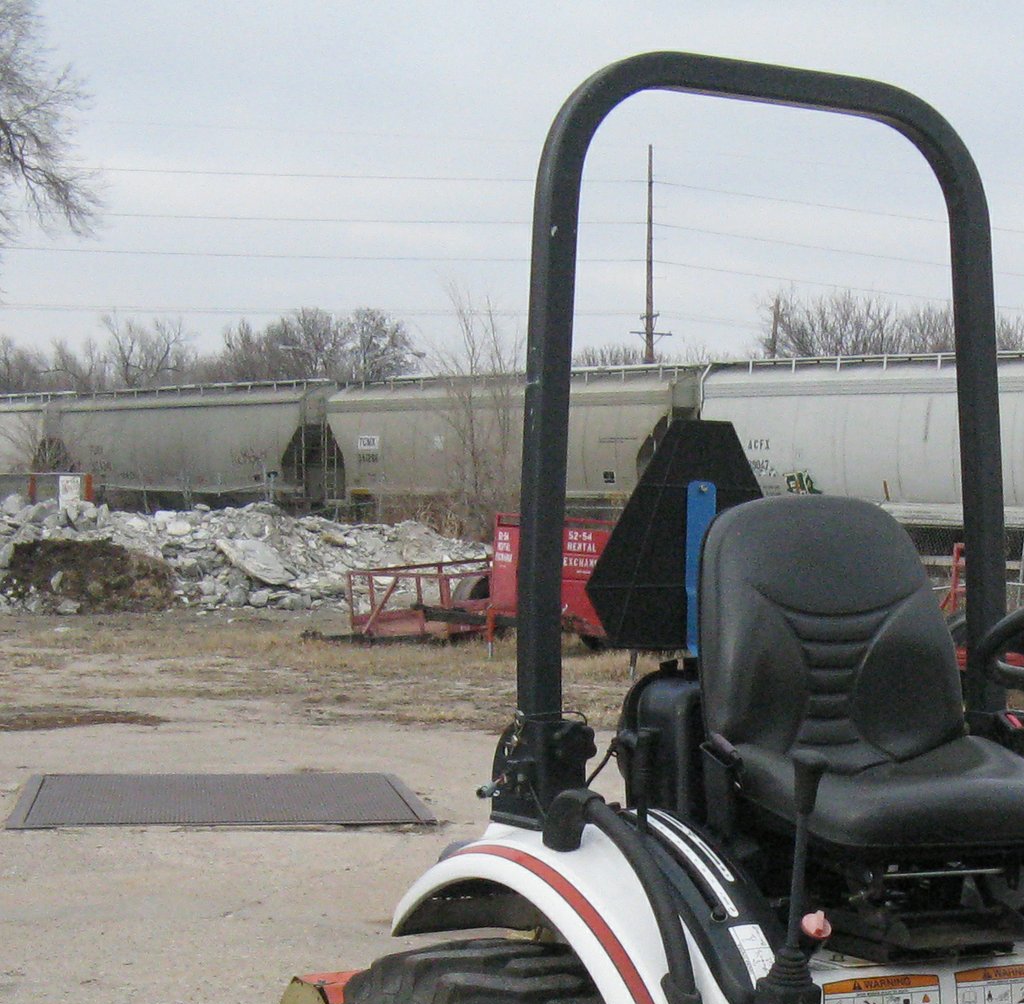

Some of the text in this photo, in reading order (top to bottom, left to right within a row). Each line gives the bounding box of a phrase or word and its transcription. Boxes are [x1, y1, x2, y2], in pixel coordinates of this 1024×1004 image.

[748, 439, 770, 450] ACFX
[567, 542, 596, 553] RENTAL
[563, 556, 598, 568] EXCHAN
[864, 977, 912, 988] WARNING
